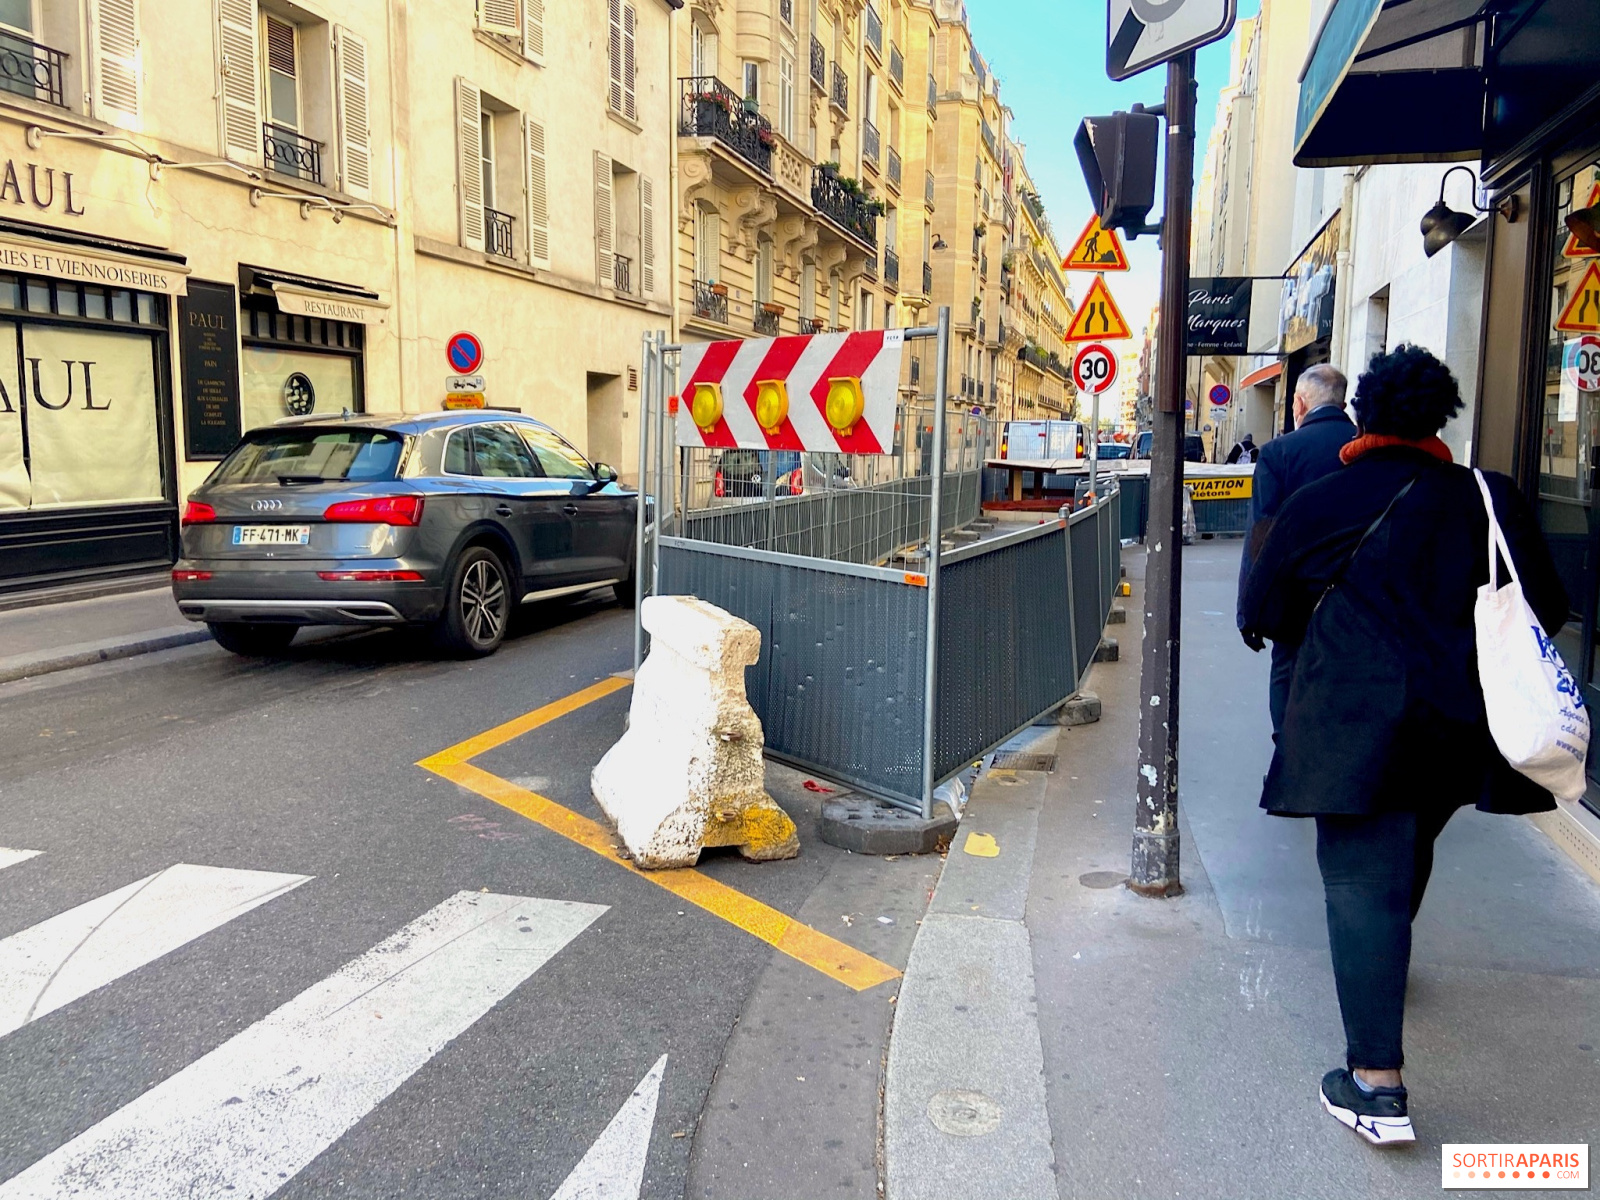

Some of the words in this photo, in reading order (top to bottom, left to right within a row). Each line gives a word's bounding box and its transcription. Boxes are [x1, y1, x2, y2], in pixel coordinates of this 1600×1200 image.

[33, 254, 52, 271] ET
[57, 258, 168, 289] VIENNOISERIES
[1188, 288, 1233, 308] Paris
[304, 300, 365, 320] RESTAURANT
[189, 311, 227, 330] PAUL
[1081, 357, 1108, 380] 30
[242, 528, 299, 541] FF-471-MK
